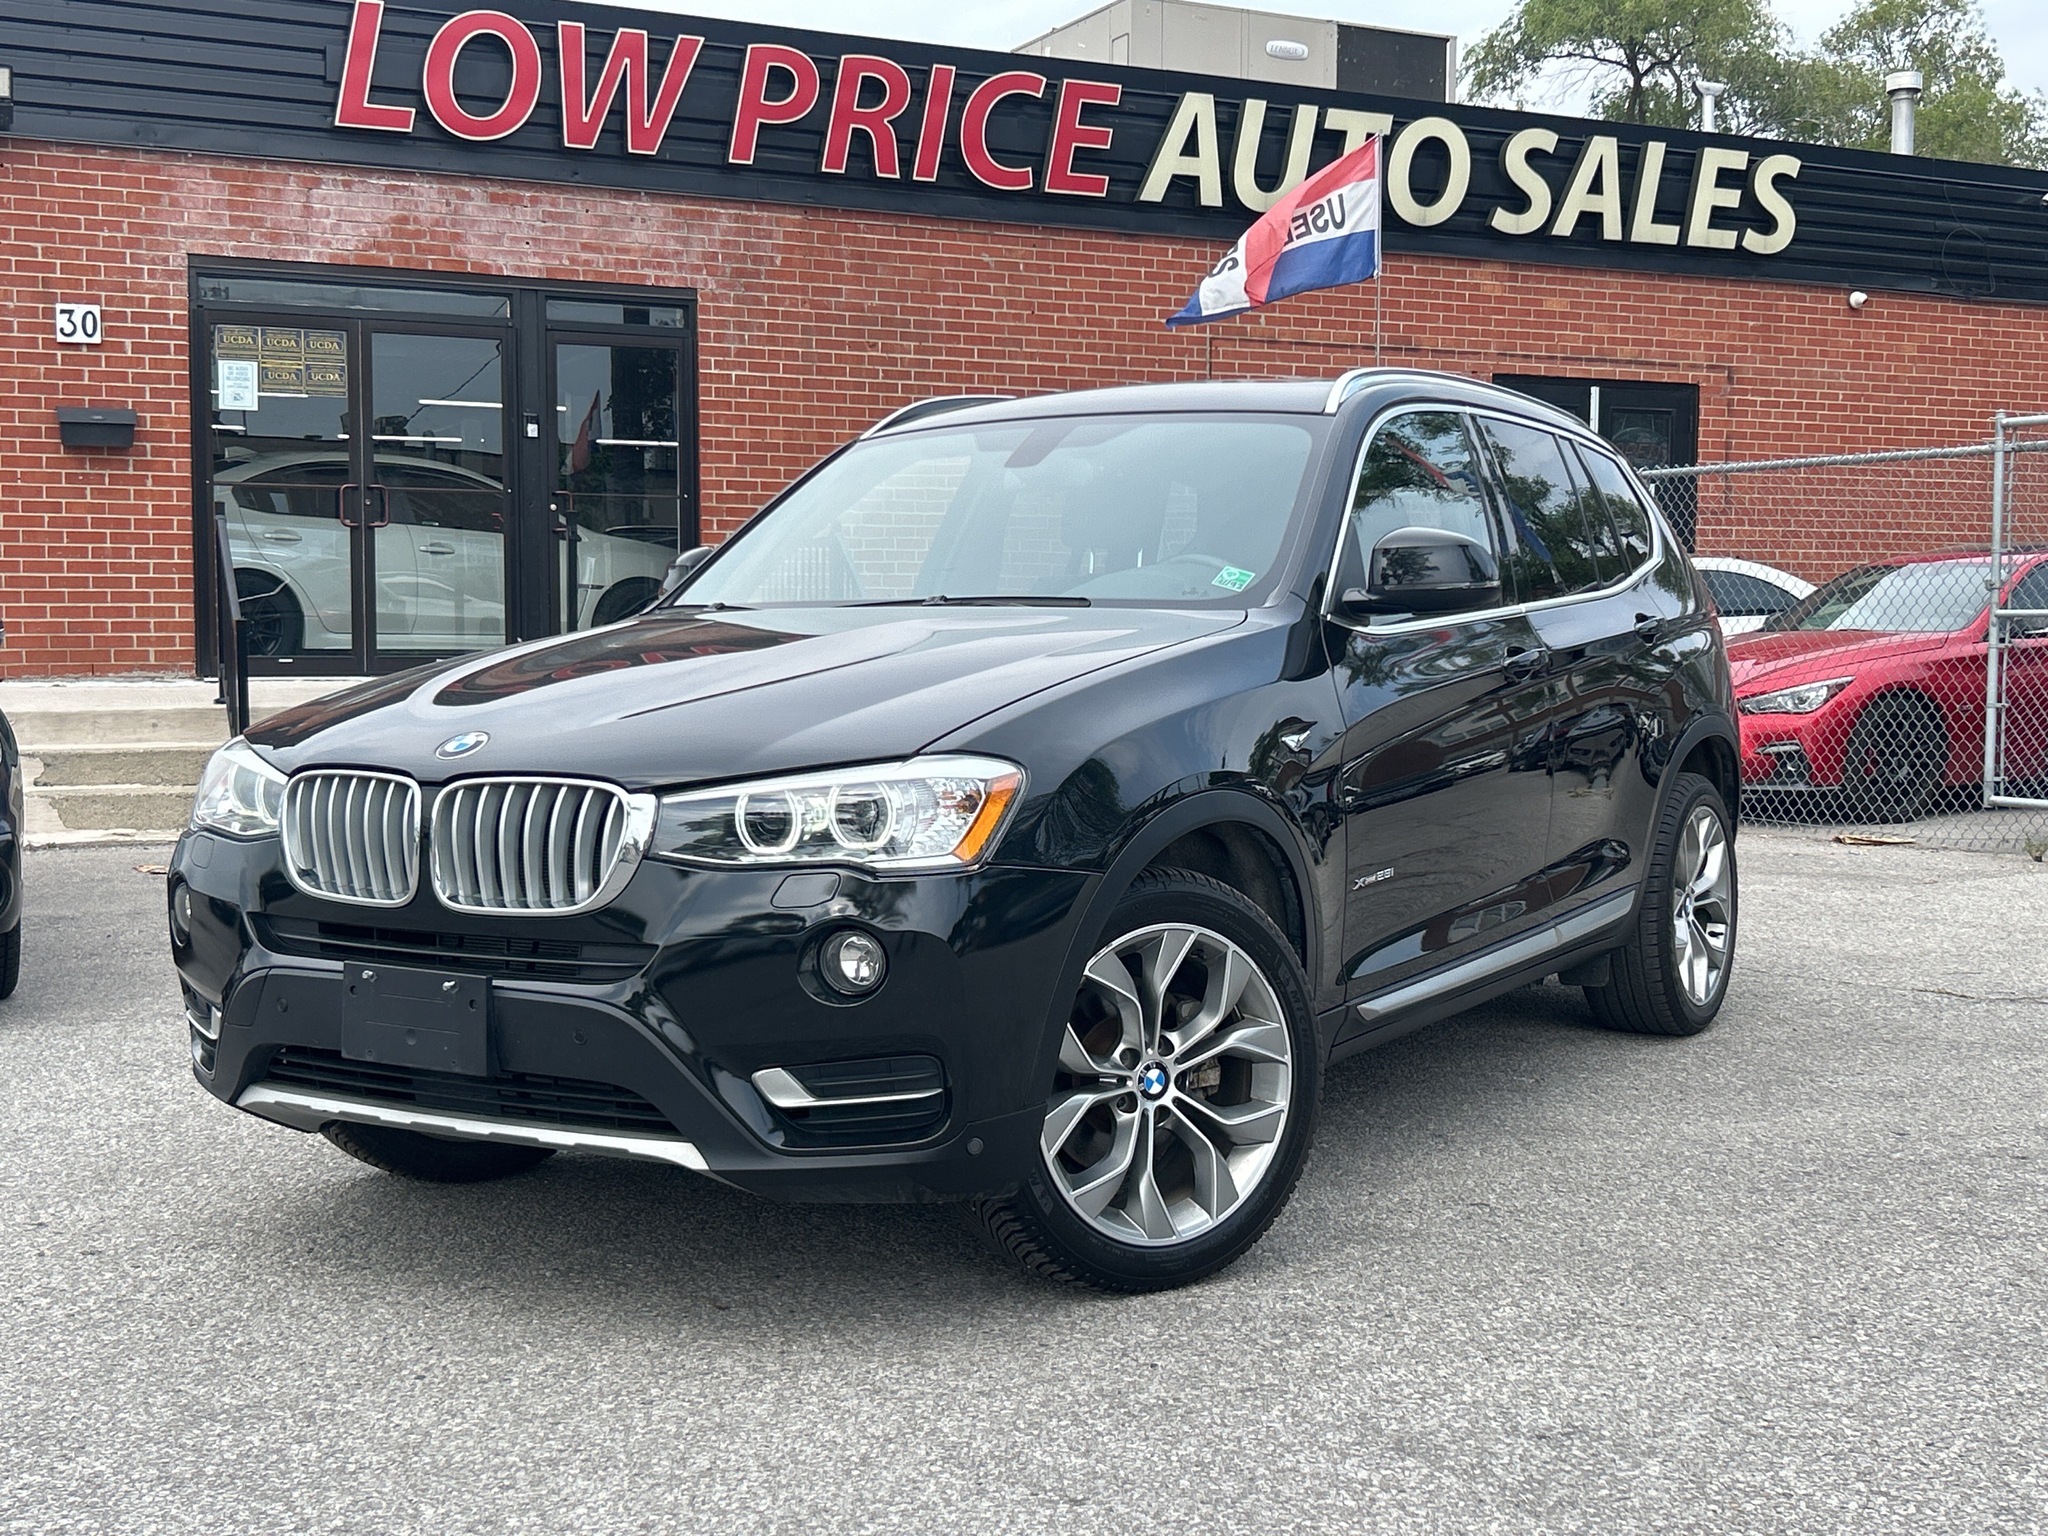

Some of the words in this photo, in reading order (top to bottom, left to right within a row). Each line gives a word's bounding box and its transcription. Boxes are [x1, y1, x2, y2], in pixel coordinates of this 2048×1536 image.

[335, 0, 706, 155] LOW
[728, 43, 1122, 197] PRICE
[1138, 91, 1472, 227] AUTO
[1490, 128, 1802, 254] SALES
[59, 308, 98, 338] 30
[223, 335, 254, 345] UCDA
[266, 338, 297, 348] UCDA
[309, 341, 340, 350] UCDA
[267, 371, 297, 380] UCDA
[311, 373, 341, 382] UCDA
